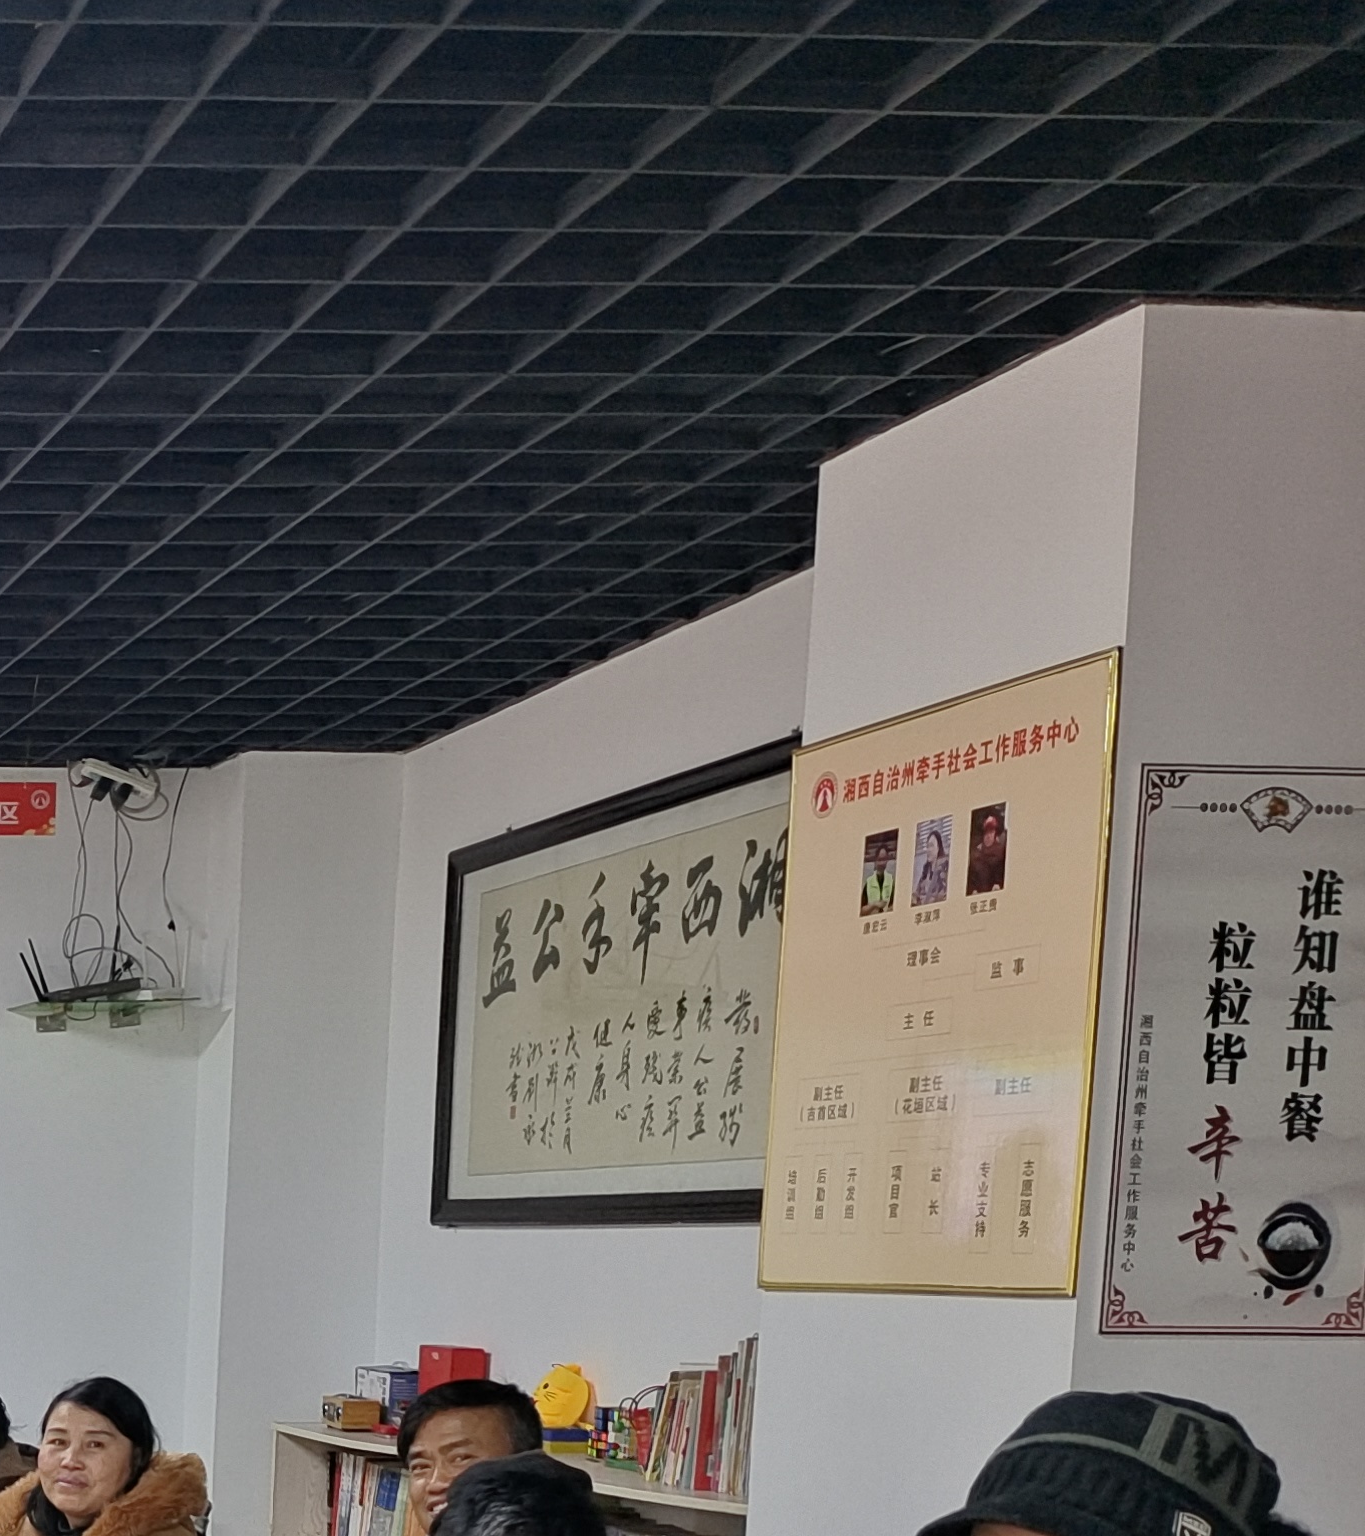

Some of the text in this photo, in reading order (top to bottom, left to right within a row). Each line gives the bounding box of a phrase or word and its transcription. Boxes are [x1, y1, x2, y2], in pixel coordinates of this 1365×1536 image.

[842, 715, 1080, 803] 湘西自治州牵手社会工作服务中心
[906, 946, 942, 967] 理事会
[902, 1009, 935, 1031] 主任
[1278, 867, 1345, 1144] 谁知盘中餐
[813, 1084, 845, 1102] 副主任
[908, 1074, 944, 1094] 副主任
[994, 1076, 1033, 1096] 副主任
[1178, 920, 1257, 1264] 粒粒皆辛苦
[1120, 1014, 1155, 1274] 湘西自治州牵手社会工作服务中心
[973, 1161, 991, 1239] 专业支持
[1017, 1159, 1035, 1238] 志愿服务
